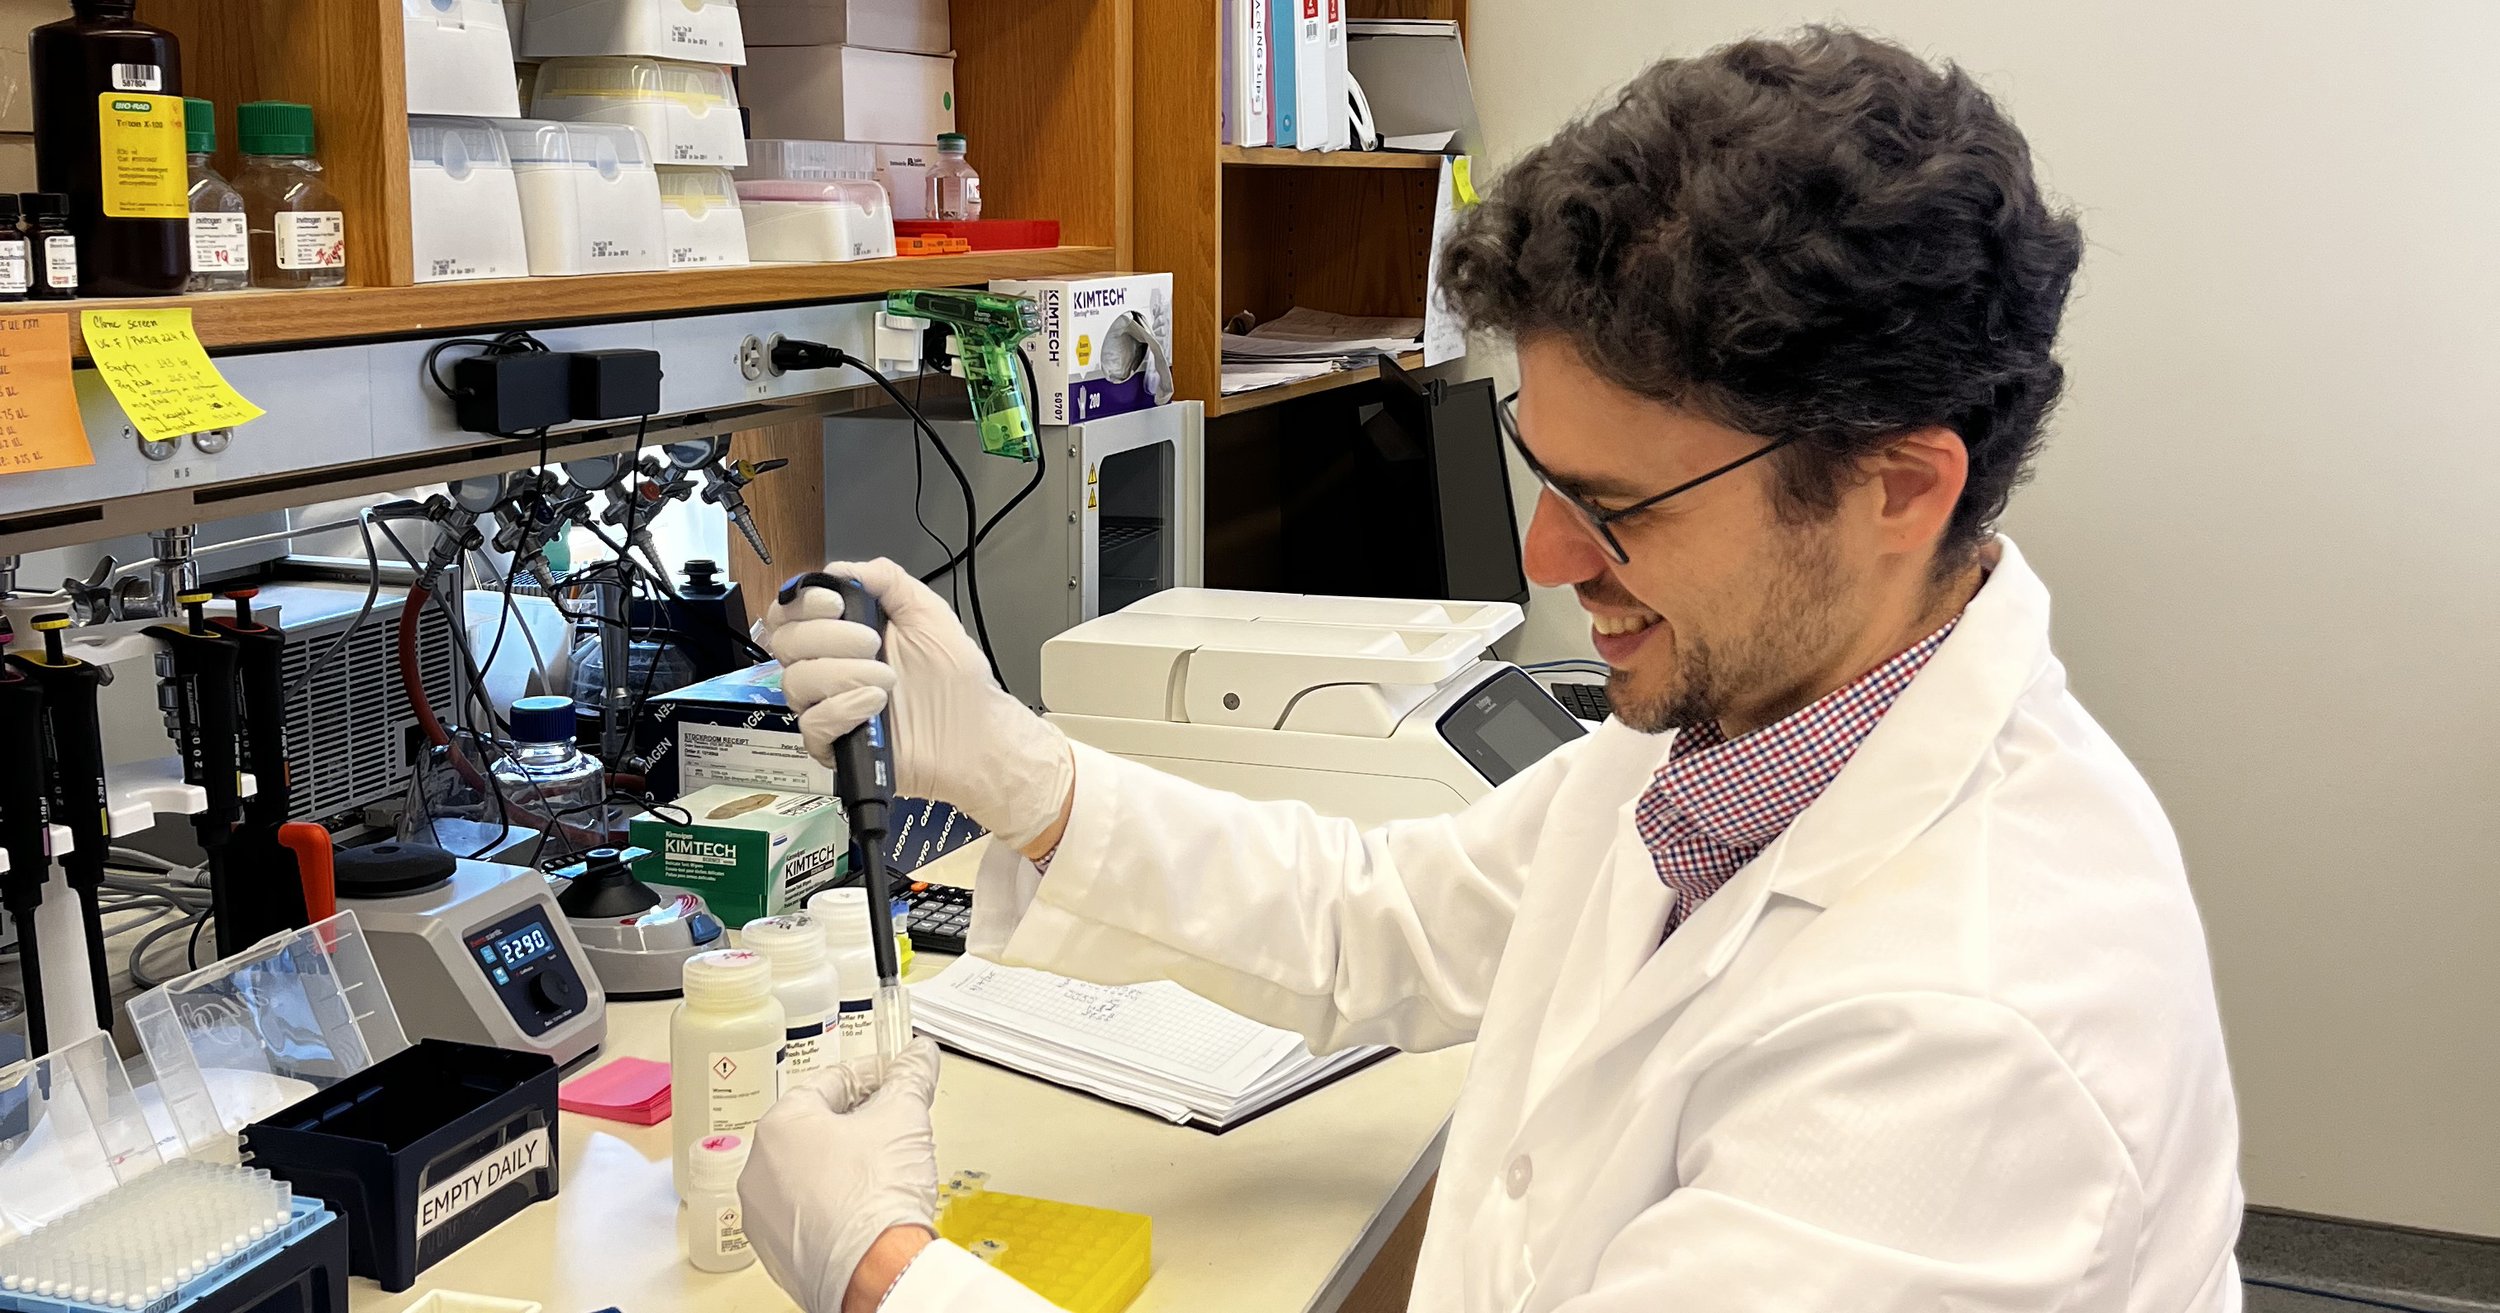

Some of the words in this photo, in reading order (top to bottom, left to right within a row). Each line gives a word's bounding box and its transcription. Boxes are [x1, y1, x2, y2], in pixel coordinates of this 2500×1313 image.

[1255, 0, 1263, 58] ACKING
[115, 102, 150, 110] BIO-RAD
[116, 119, 141, 127] Triton
[1073, 287, 1125, 310] KIMTECH
[127, 319, 158, 329] screen
[1049, 290, 1059, 362] KIMTECH
[1055, 392, 1063, 420] 50707
[1089, 392, 1101, 410] 200
[685, 732, 721, 743] STOCKROOM
[723, 736, 749, 745] RECEIPT
[644, 737, 672, 774] IAGEN
[892, 814, 914, 861] QIAGEN
[937, 806, 957, 852] QIAGEN
[665, 838, 736, 858] KIMTECH
[785, 843, 835, 880] KIMTECH
[501, 929, 546, 964] 2290
[786, 1041, 806, 1049] Buffer
[801, 1047, 820, 1056] buffer
[422, 1170, 483, 1227] EMPTY
[488, 1139, 537, 1187] DAILY
